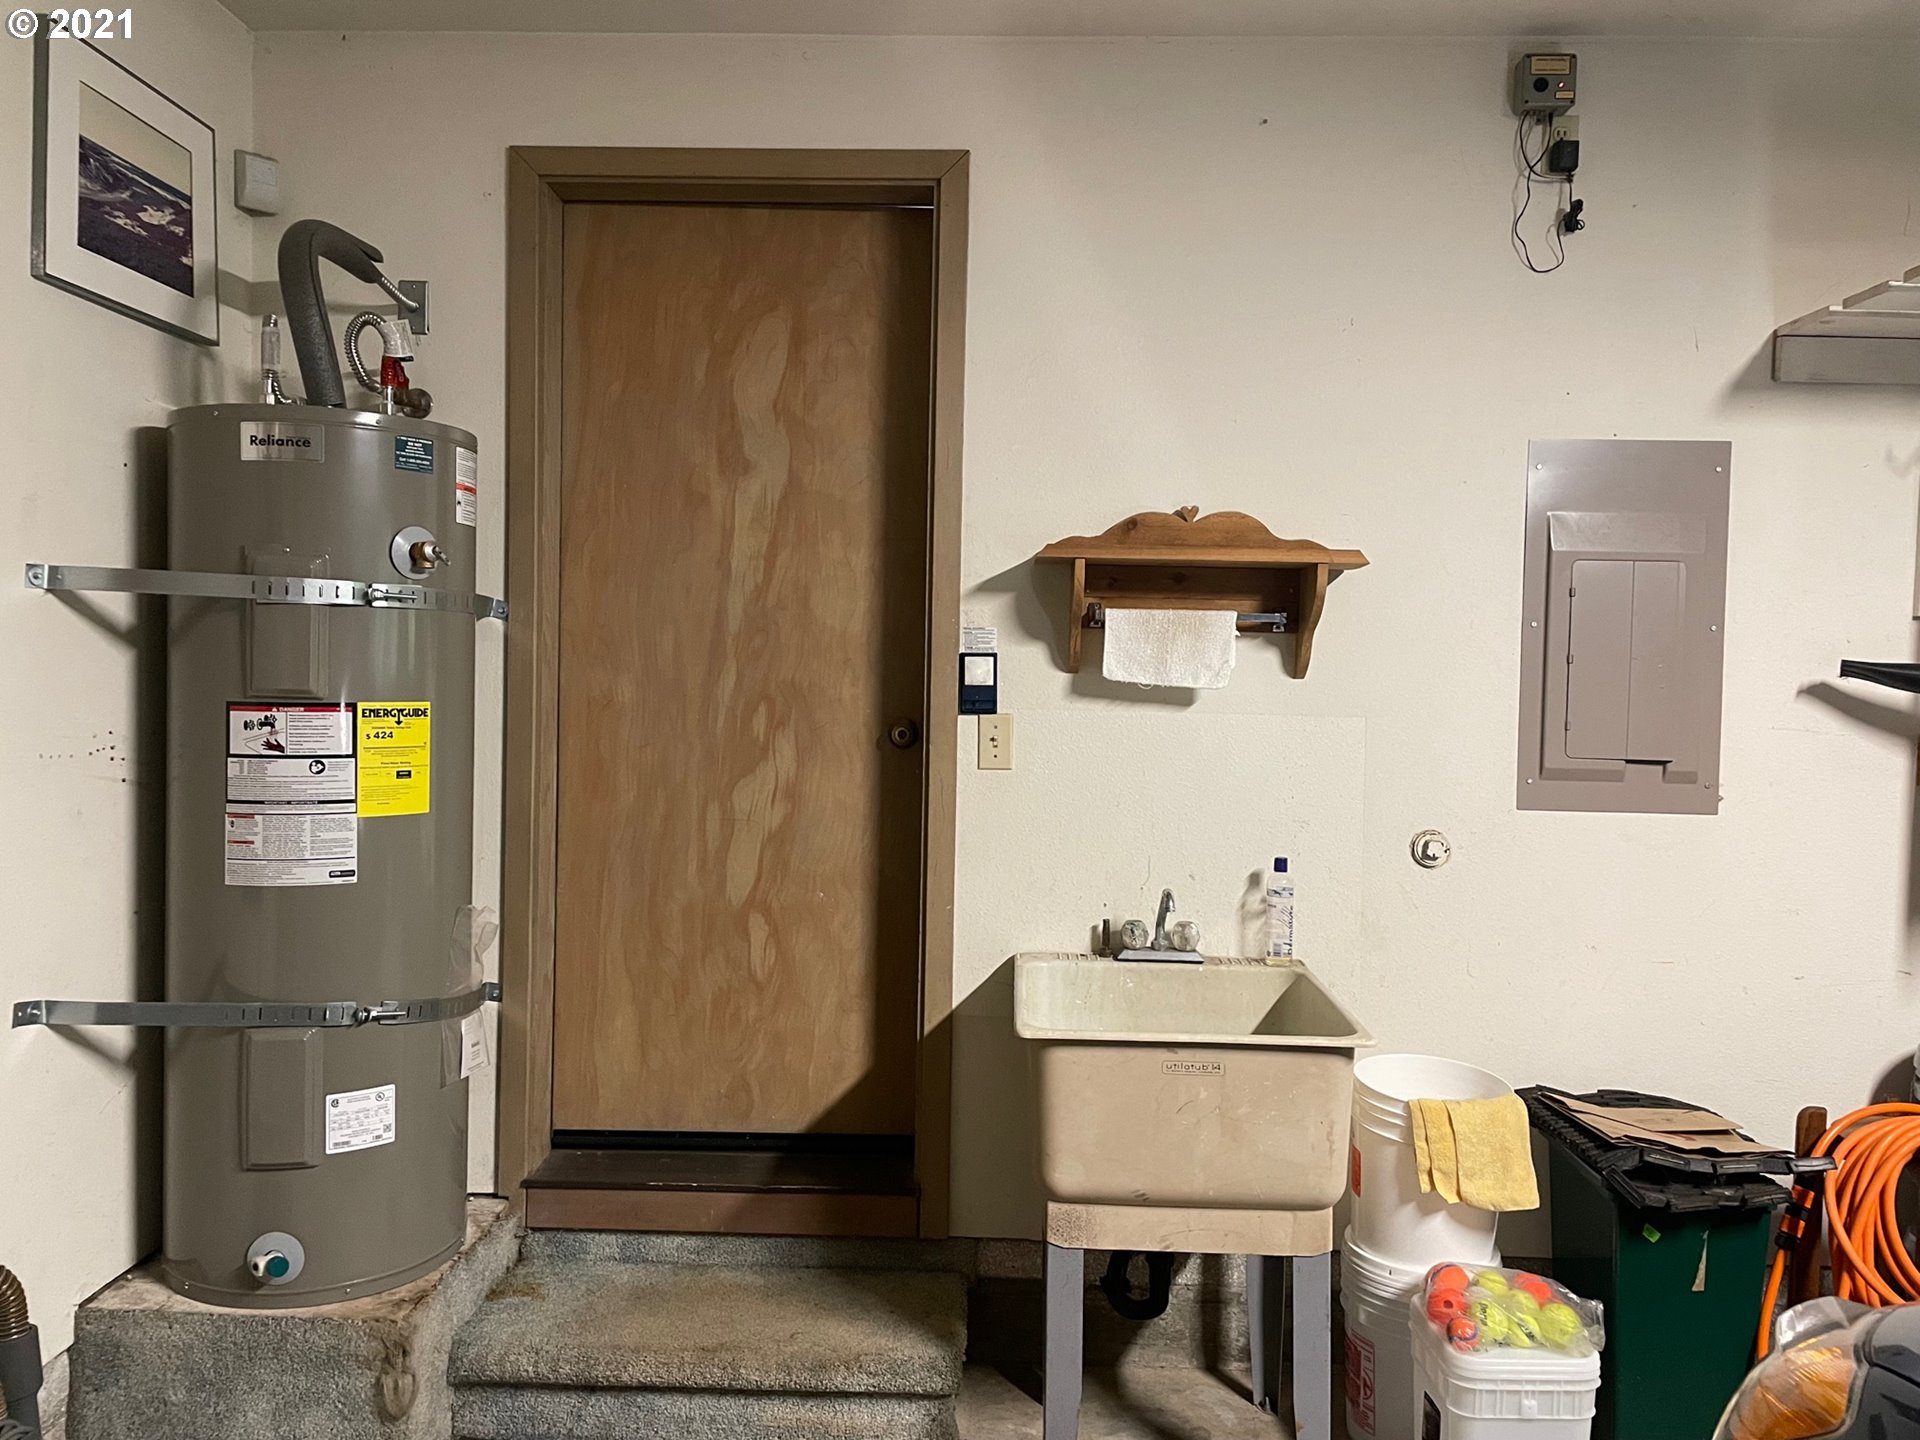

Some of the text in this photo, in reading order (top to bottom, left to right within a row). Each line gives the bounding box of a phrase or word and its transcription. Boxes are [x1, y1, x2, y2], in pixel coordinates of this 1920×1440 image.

[249, 434, 312, 448] Reliance
[361, 707, 429, 719] ENERGYGUIDE
[373, 731, 394, 739] 424
